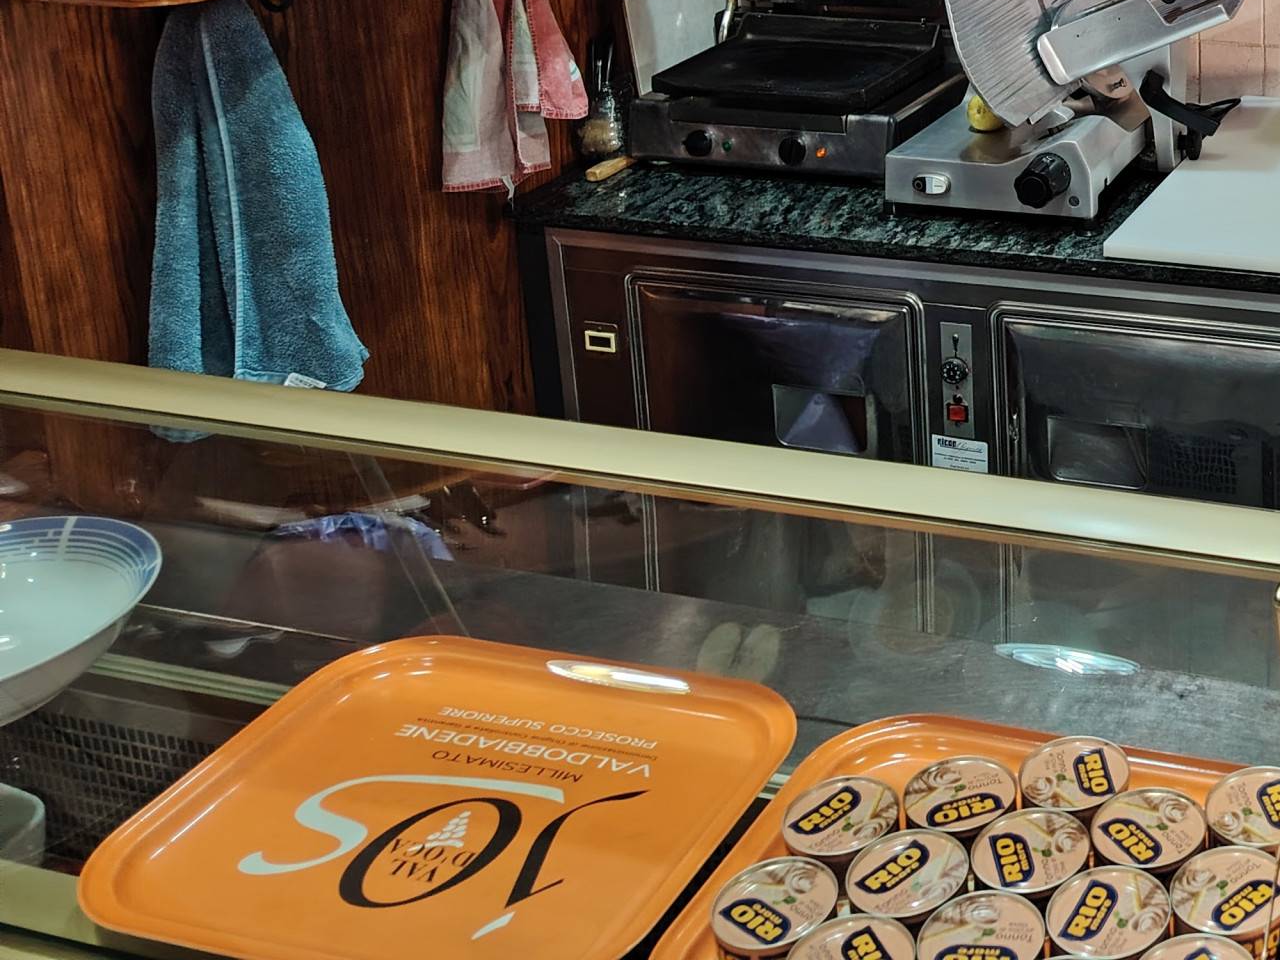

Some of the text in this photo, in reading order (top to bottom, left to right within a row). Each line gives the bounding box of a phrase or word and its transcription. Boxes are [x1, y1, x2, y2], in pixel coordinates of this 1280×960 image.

[438, 706, 658, 751] PROSECCO SUPERIORE
[394, 724, 651, 778] VALDOBBIADENE
[432, 750, 583, 783] MILLESIMATO
[1083, 752, 1109, 794] RIO
[798, 792, 853, 832] RIO
[933, 798, 996, 823] RIO
[996, 838, 1023, 883] RIO
[1108, 822, 1156, 862] RIO
[389, 858, 438, 884] VAL
[864, 848, 922, 891] RIO
[730, 904, 784, 942] RIO
[1066, 886, 1108, 938] RIO
[1220, 884, 1274, 926] RIO
